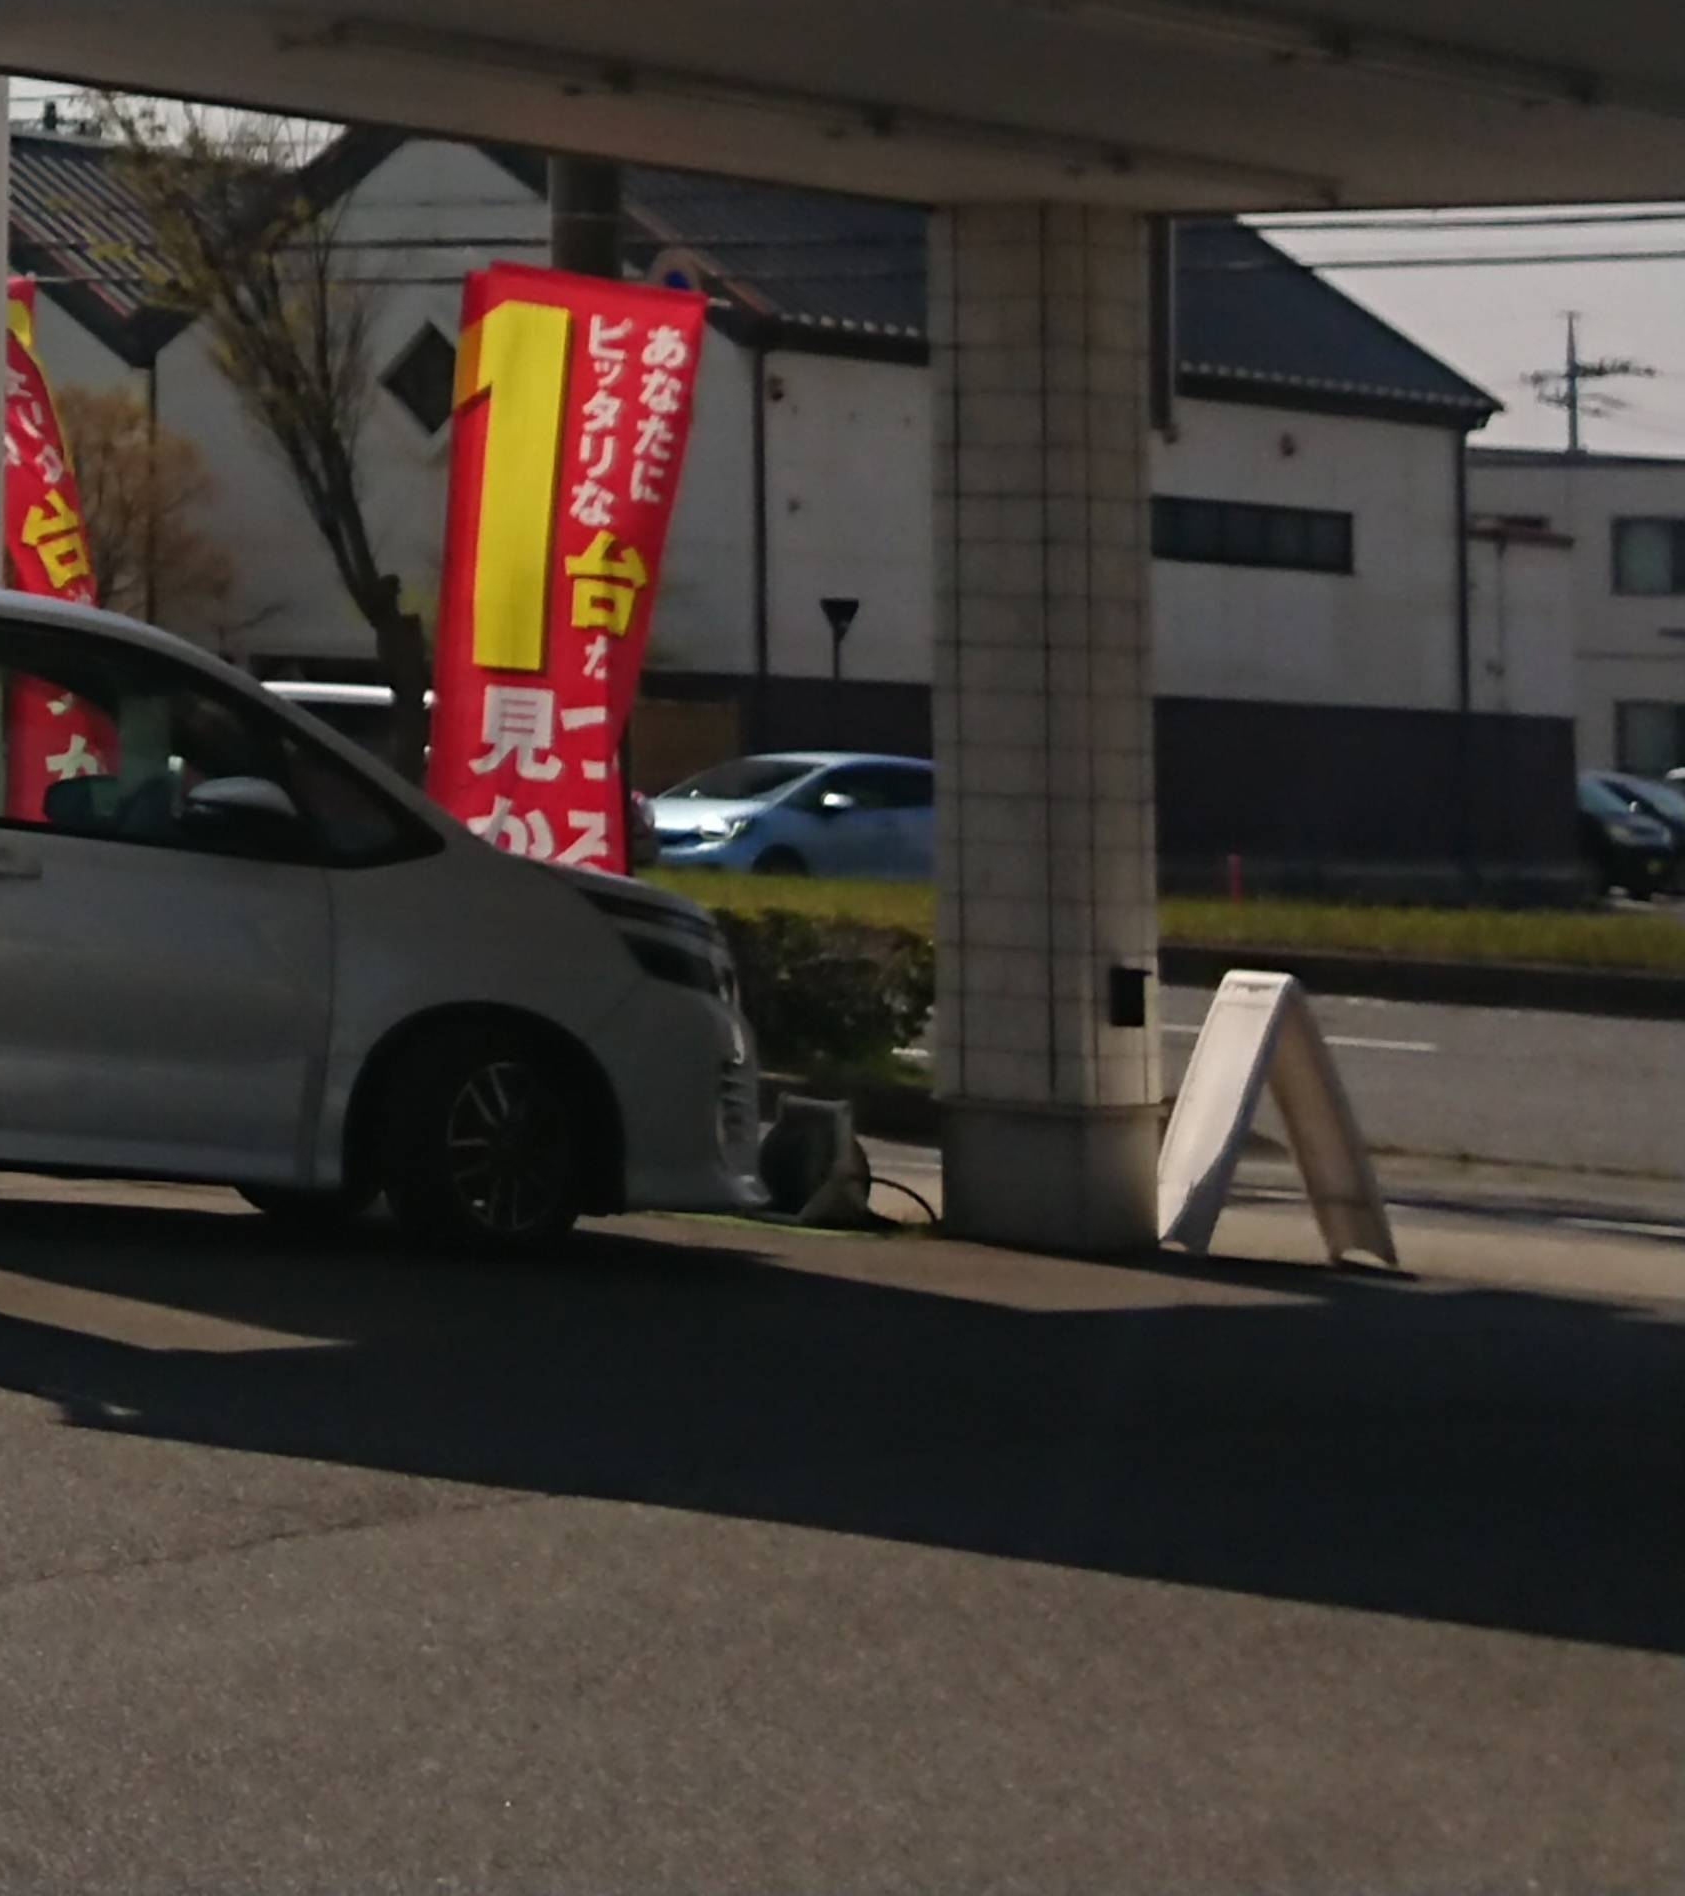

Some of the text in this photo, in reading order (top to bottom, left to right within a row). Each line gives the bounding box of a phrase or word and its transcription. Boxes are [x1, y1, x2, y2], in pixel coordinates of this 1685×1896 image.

[567, 312, 632, 528] ピッタリな
[628, 324, 692, 504] あなたに
